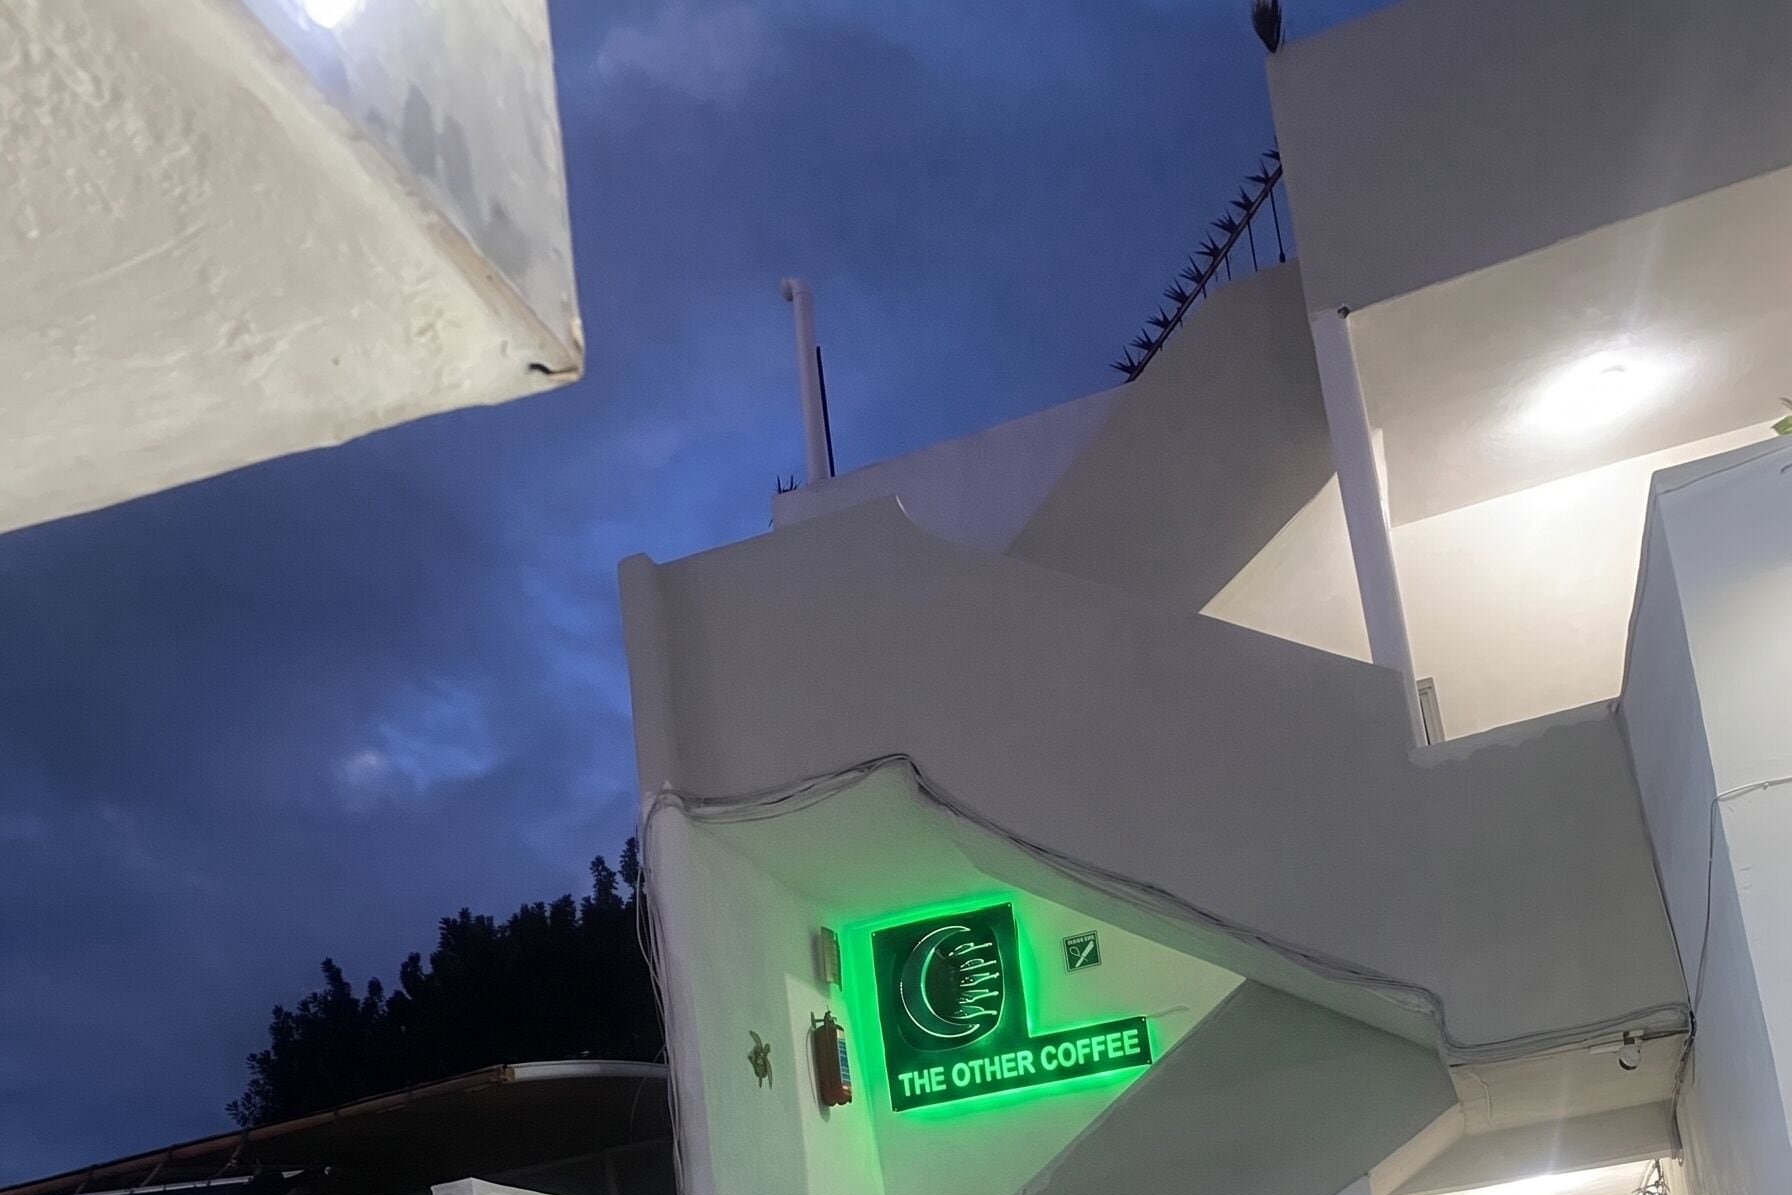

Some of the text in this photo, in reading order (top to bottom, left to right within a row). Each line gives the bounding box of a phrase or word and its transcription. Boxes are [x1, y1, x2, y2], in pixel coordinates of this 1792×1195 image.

[898, 1029, 1141, 1097] THE OTHER COFFEE
